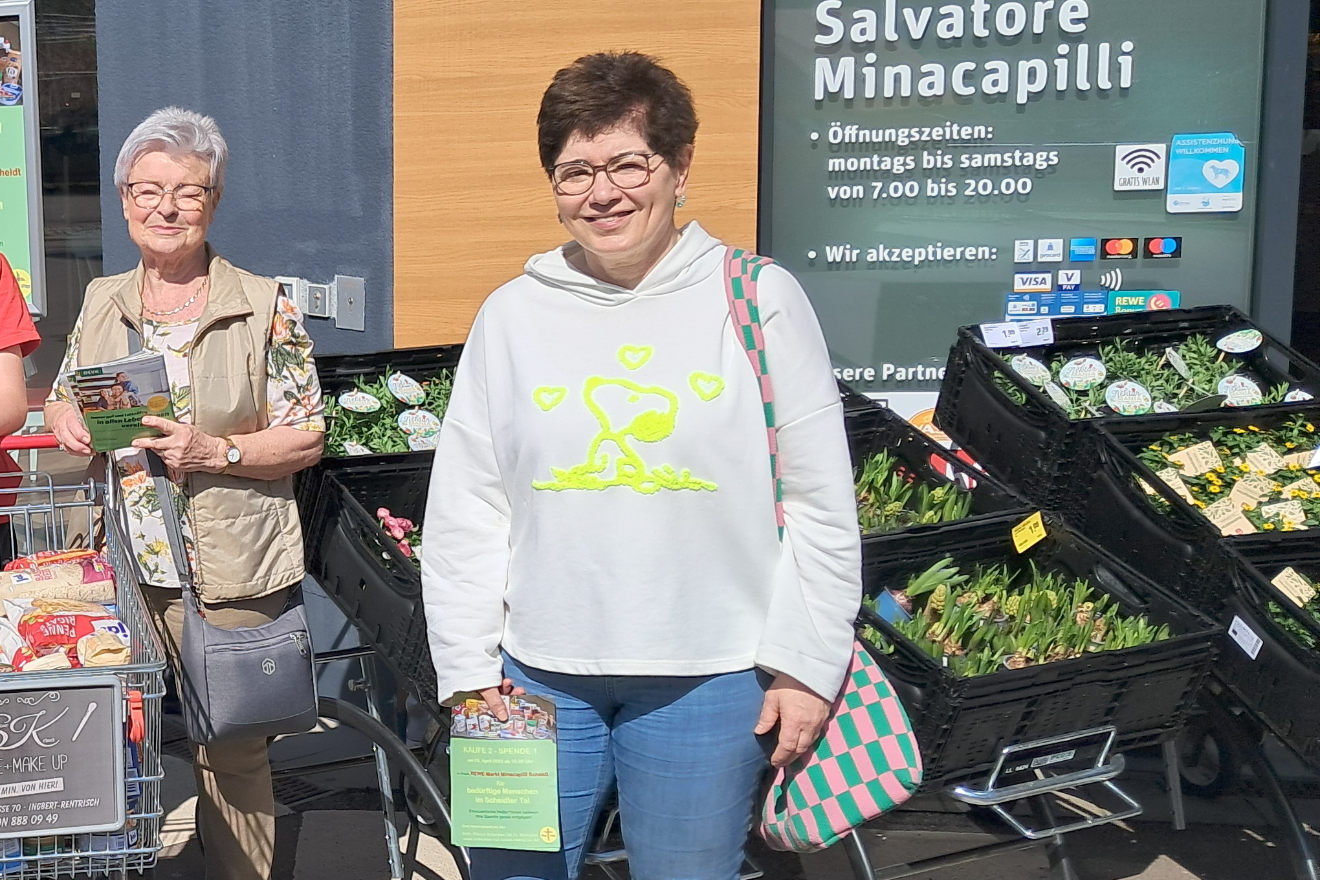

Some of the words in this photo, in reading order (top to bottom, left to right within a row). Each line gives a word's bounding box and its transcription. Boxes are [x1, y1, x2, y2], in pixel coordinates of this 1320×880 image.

[814, 0, 1089, 44] Salvatore
[814, 41, 1134, 104] Minacapilli
[828, 121, 994, 146] Öffnungszeiten:
[1175, 147, 1229, 155] WILLKOMMEN
[828, 153, 915, 174] montags
[922, 150, 953, 169] bis
[959, 149, 1060, 170] samstags
[827, 184, 864, 200] von
[871, 181, 919, 199] 7.00
[926, 178, 957, 197] bis
[963, 177, 1033, 196] 20.00
[1141, 176, 1160, 187] WLAN
[825, 244, 860, 263] Wir
[866, 242, 998, 265] akzeptieren:
[1019, 277, 1047, 286] VISA
[1063, 272, 1076, 282] V
[1115, 296, 1145, 306] REWE
[833, 366, 876, 380] sere
[882, 363, 946, 381] Partne
[42, 624, 76, 638] PENNE
[463, 746, 487, 754] KAUFE
[498, 747, 531, 755] SPENDE
[51, 754, 68, 771] UP
[0, 785, 19, 795] MIN.
[21, 783, 36, 792] VON
[38, 780, 59, 790] HIER!
[11, 803, 22, 813] 70
[10, 815, 28, 826] 888
[30, 814, 44, 825] 09
[45, 813, 59, 824] 49
